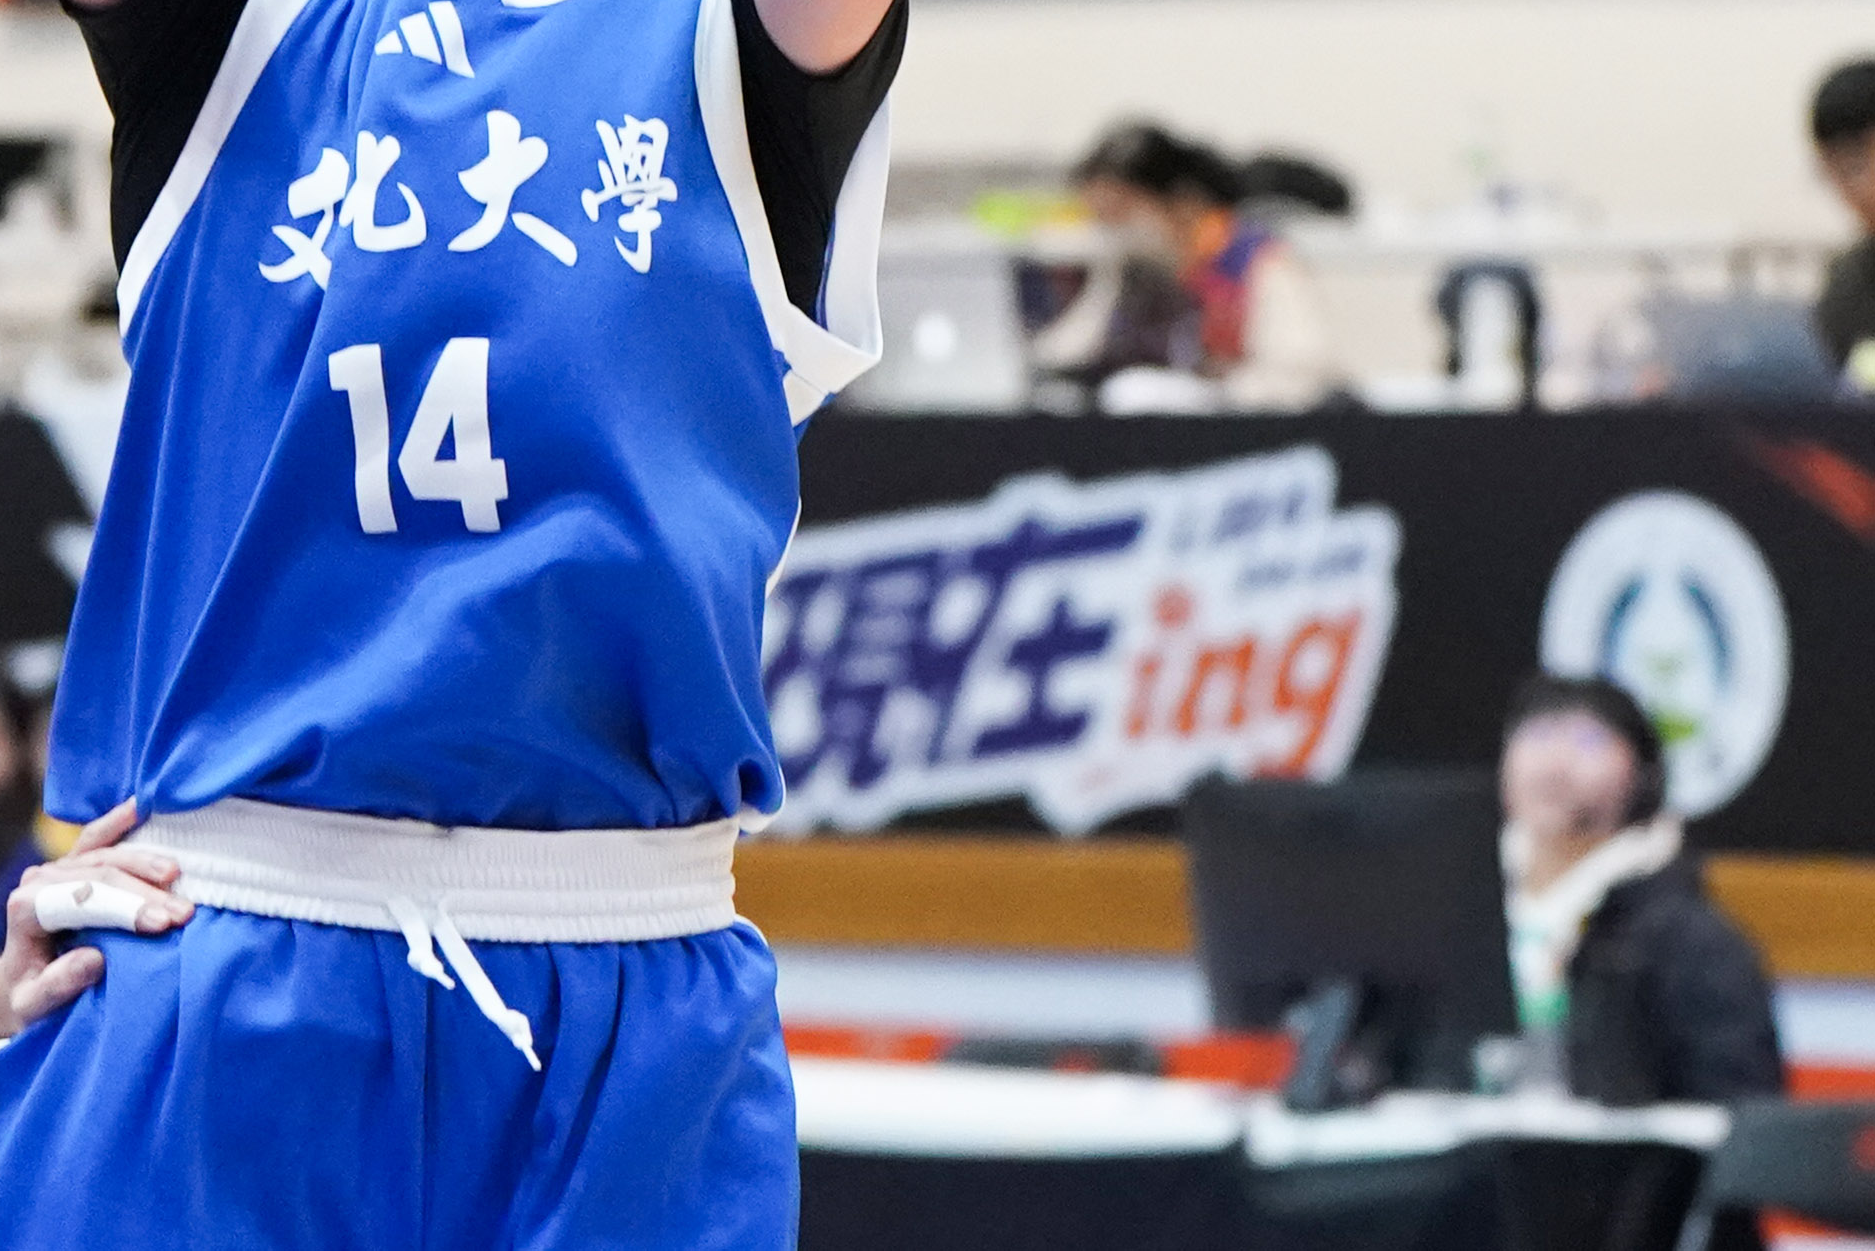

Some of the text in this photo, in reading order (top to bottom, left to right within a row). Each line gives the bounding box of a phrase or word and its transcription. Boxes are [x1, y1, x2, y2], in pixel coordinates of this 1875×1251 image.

[258, 110, 678, 291] 文化大學
[328, 337, 508, 534] 14
